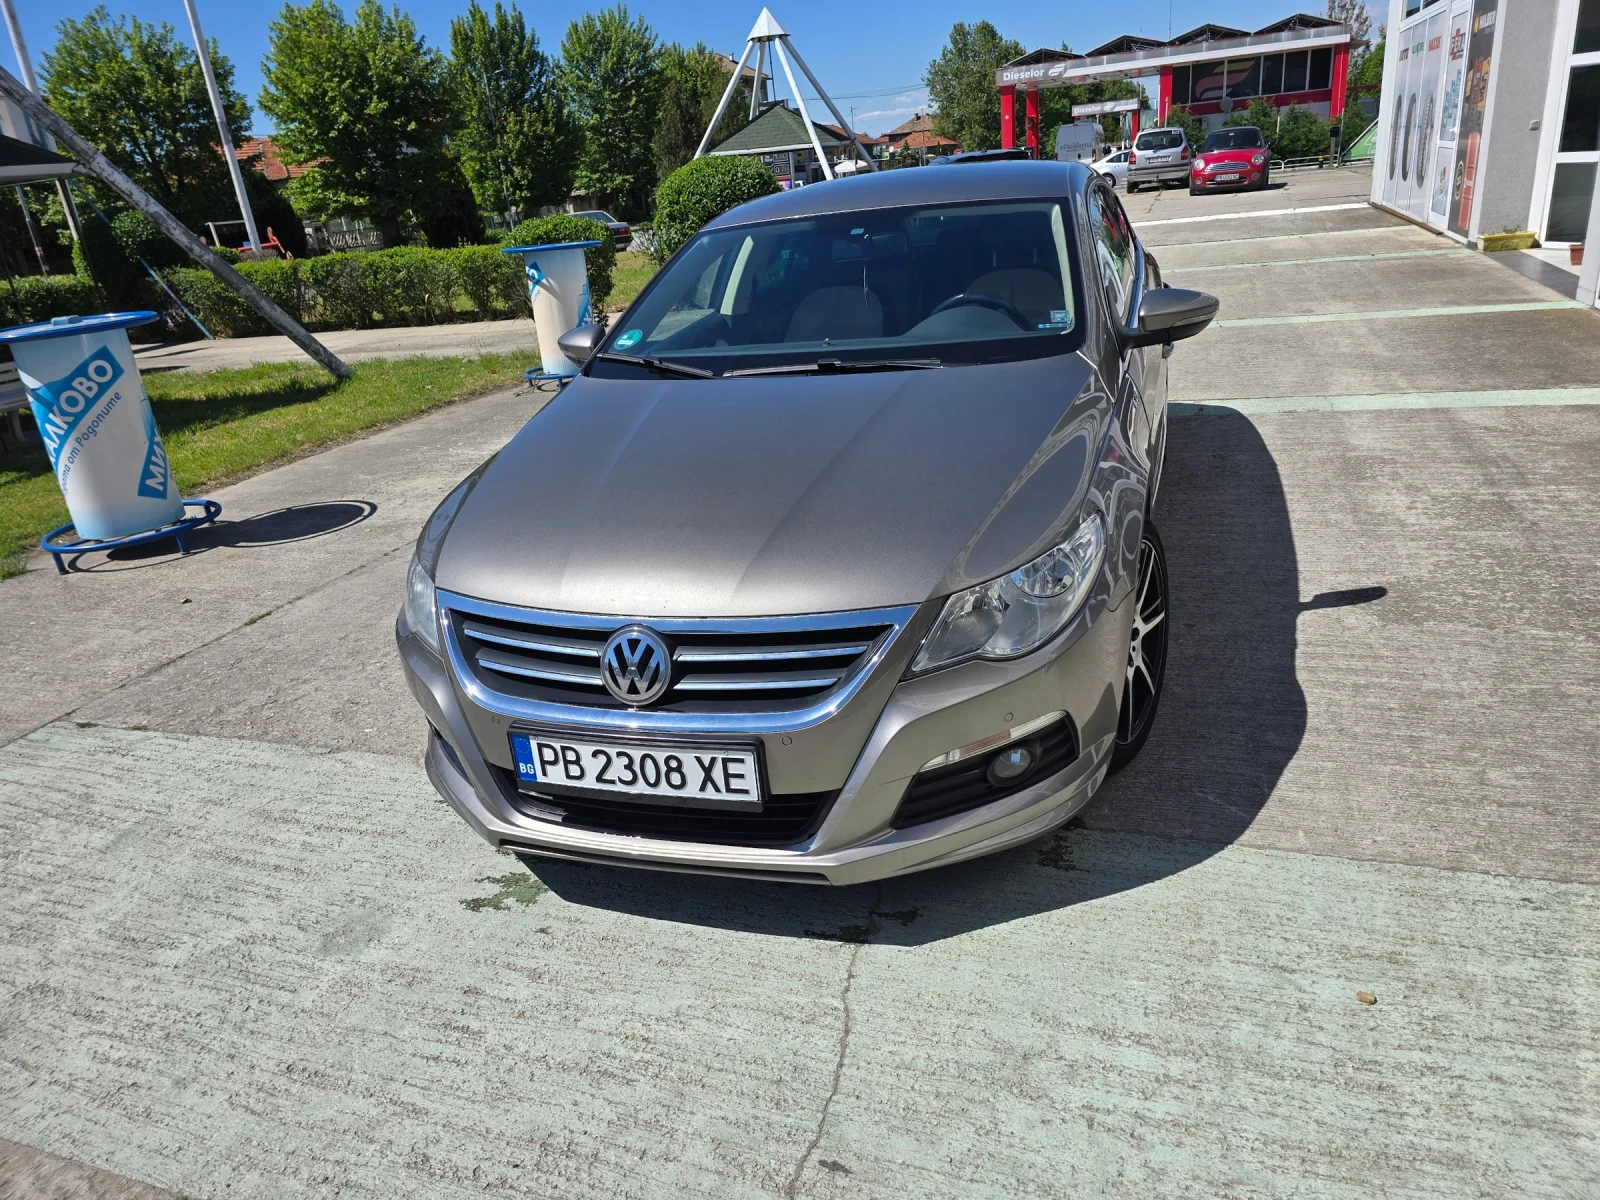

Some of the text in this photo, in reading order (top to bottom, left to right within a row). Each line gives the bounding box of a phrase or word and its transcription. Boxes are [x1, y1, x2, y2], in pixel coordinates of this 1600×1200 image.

[1003, 68, 1045, 81] Dieselor
[1074, 105, 1102, 114] Dieselor
[519, 762, 535, 775] BG
[536, 742, 750, 795] PB 2308 XE
